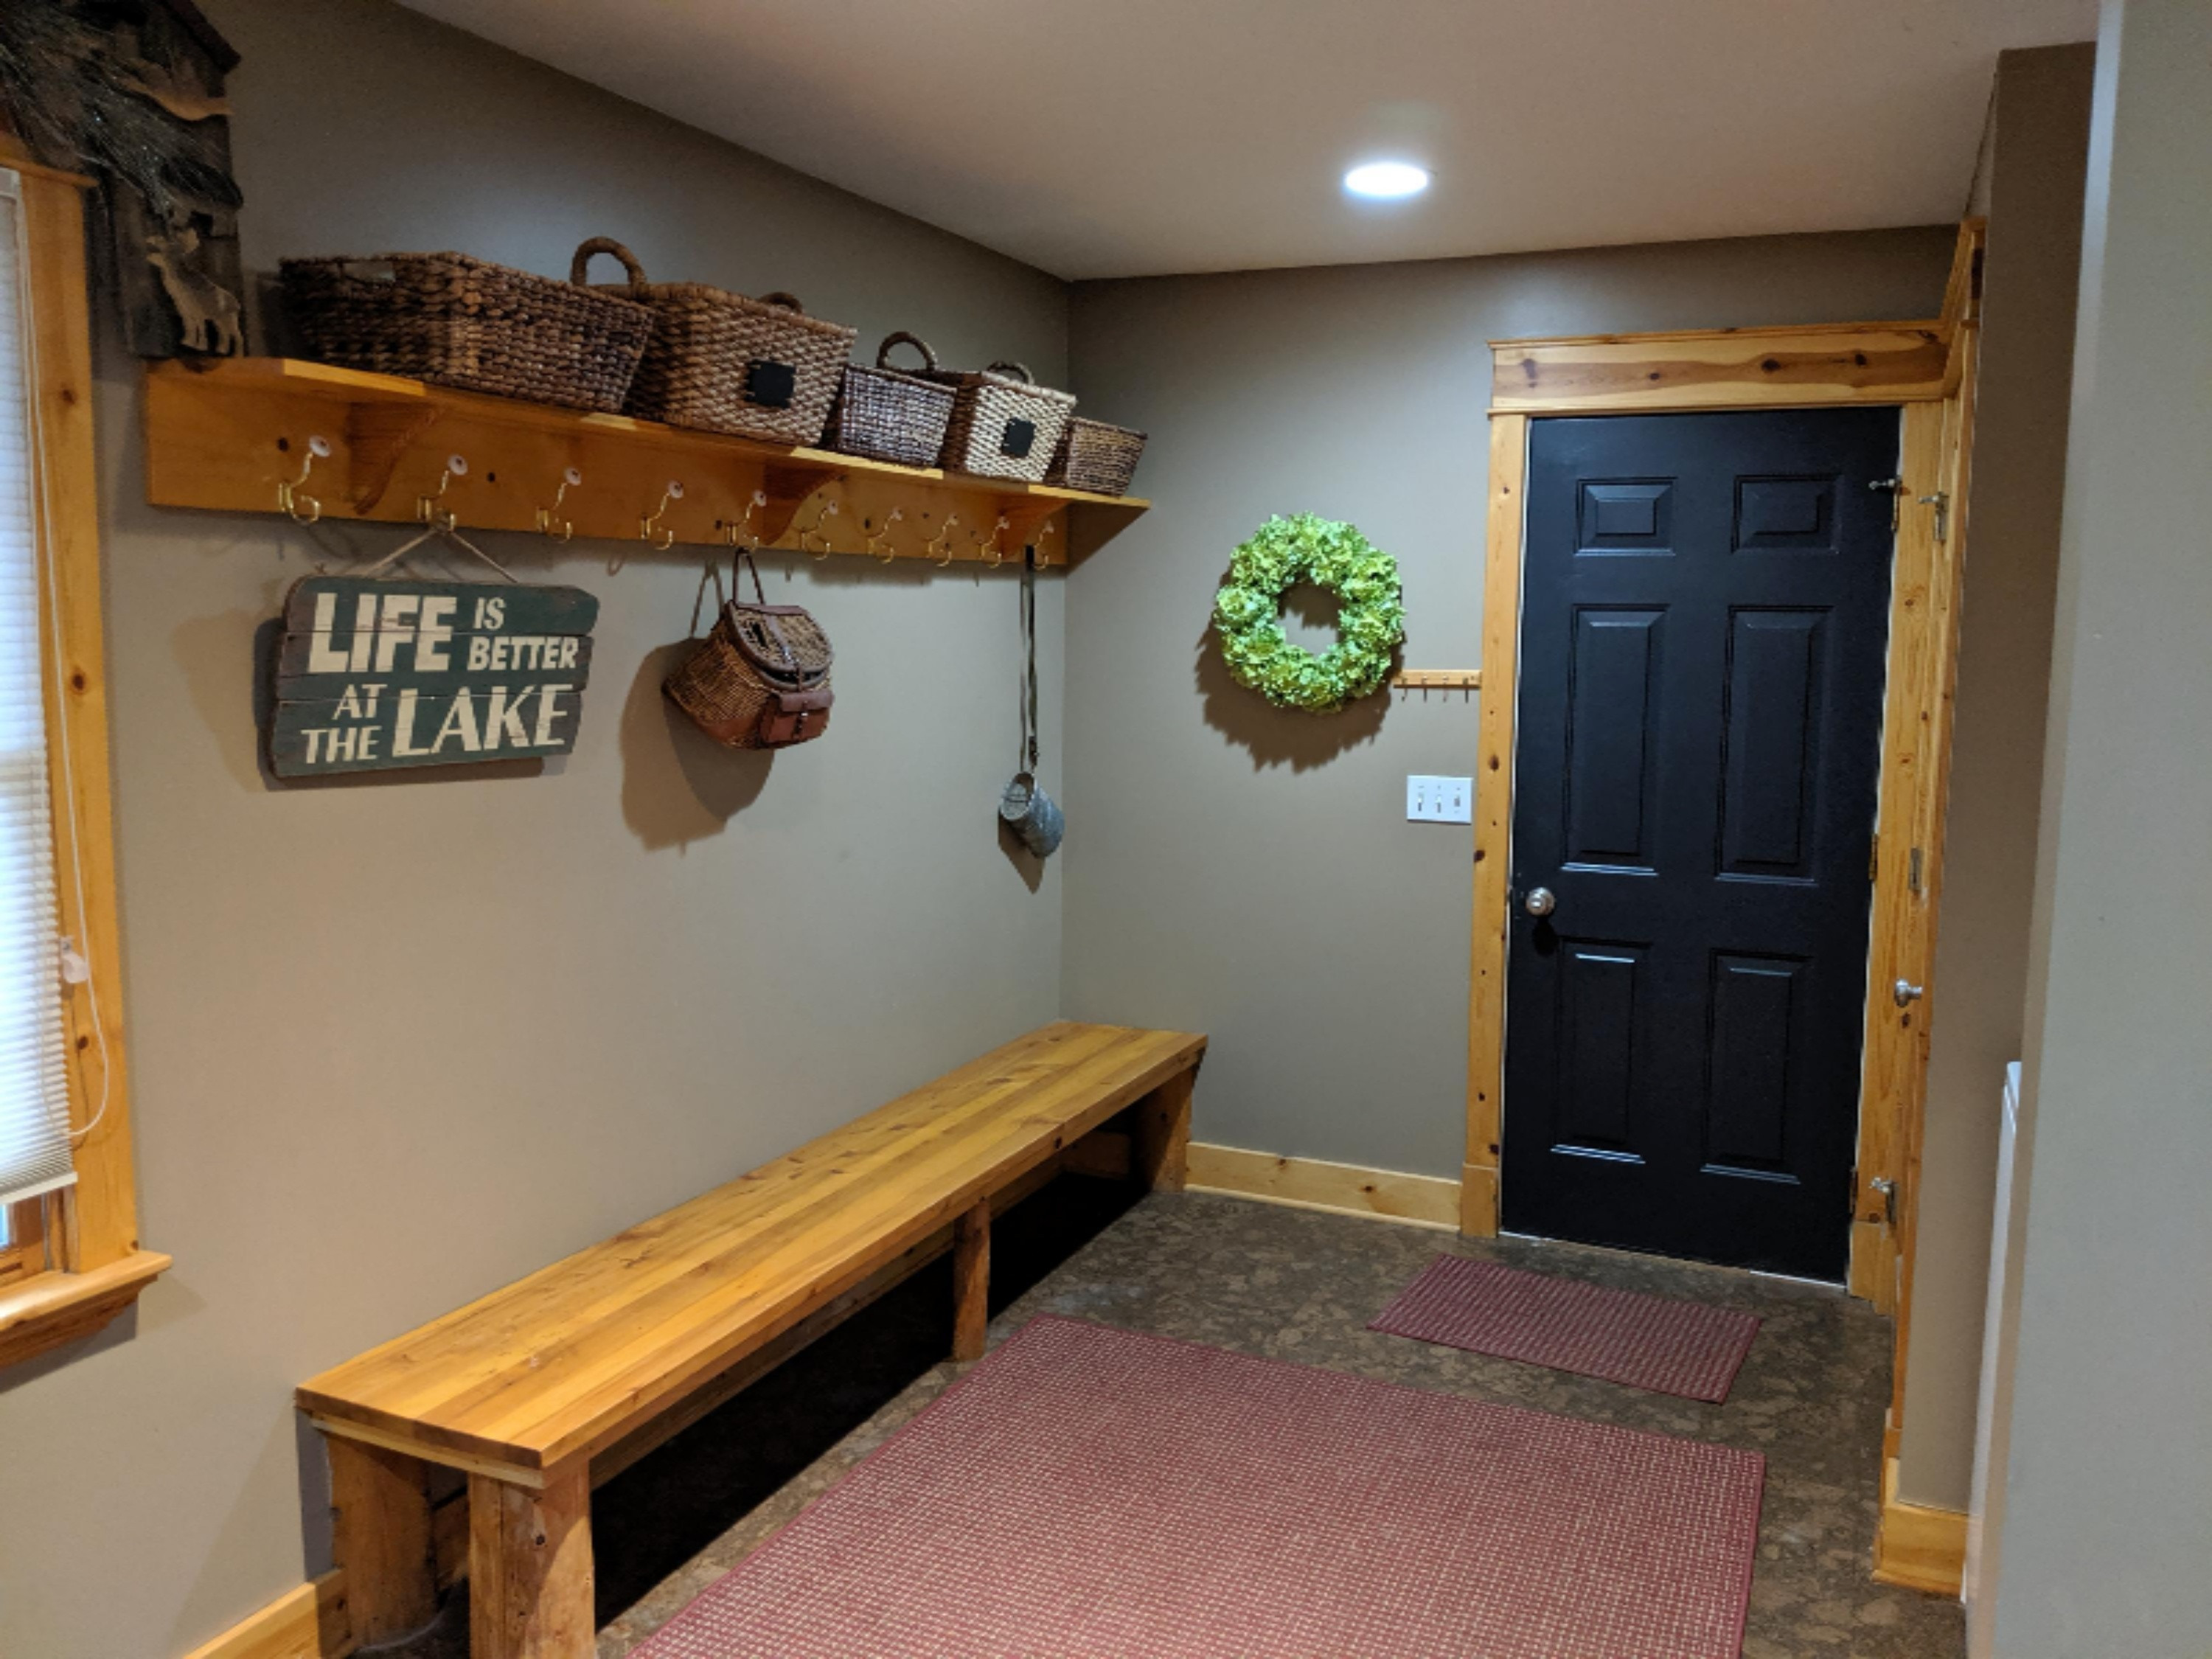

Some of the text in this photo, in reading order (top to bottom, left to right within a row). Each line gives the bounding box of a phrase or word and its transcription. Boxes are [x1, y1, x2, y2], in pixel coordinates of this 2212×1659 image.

[308, 593, 507, 672] LIFE IS
[467, 636, 579, 671] BETTER
[301, 684, 573, 764] THE LAKE
[332, 684, 388, 720] AT
